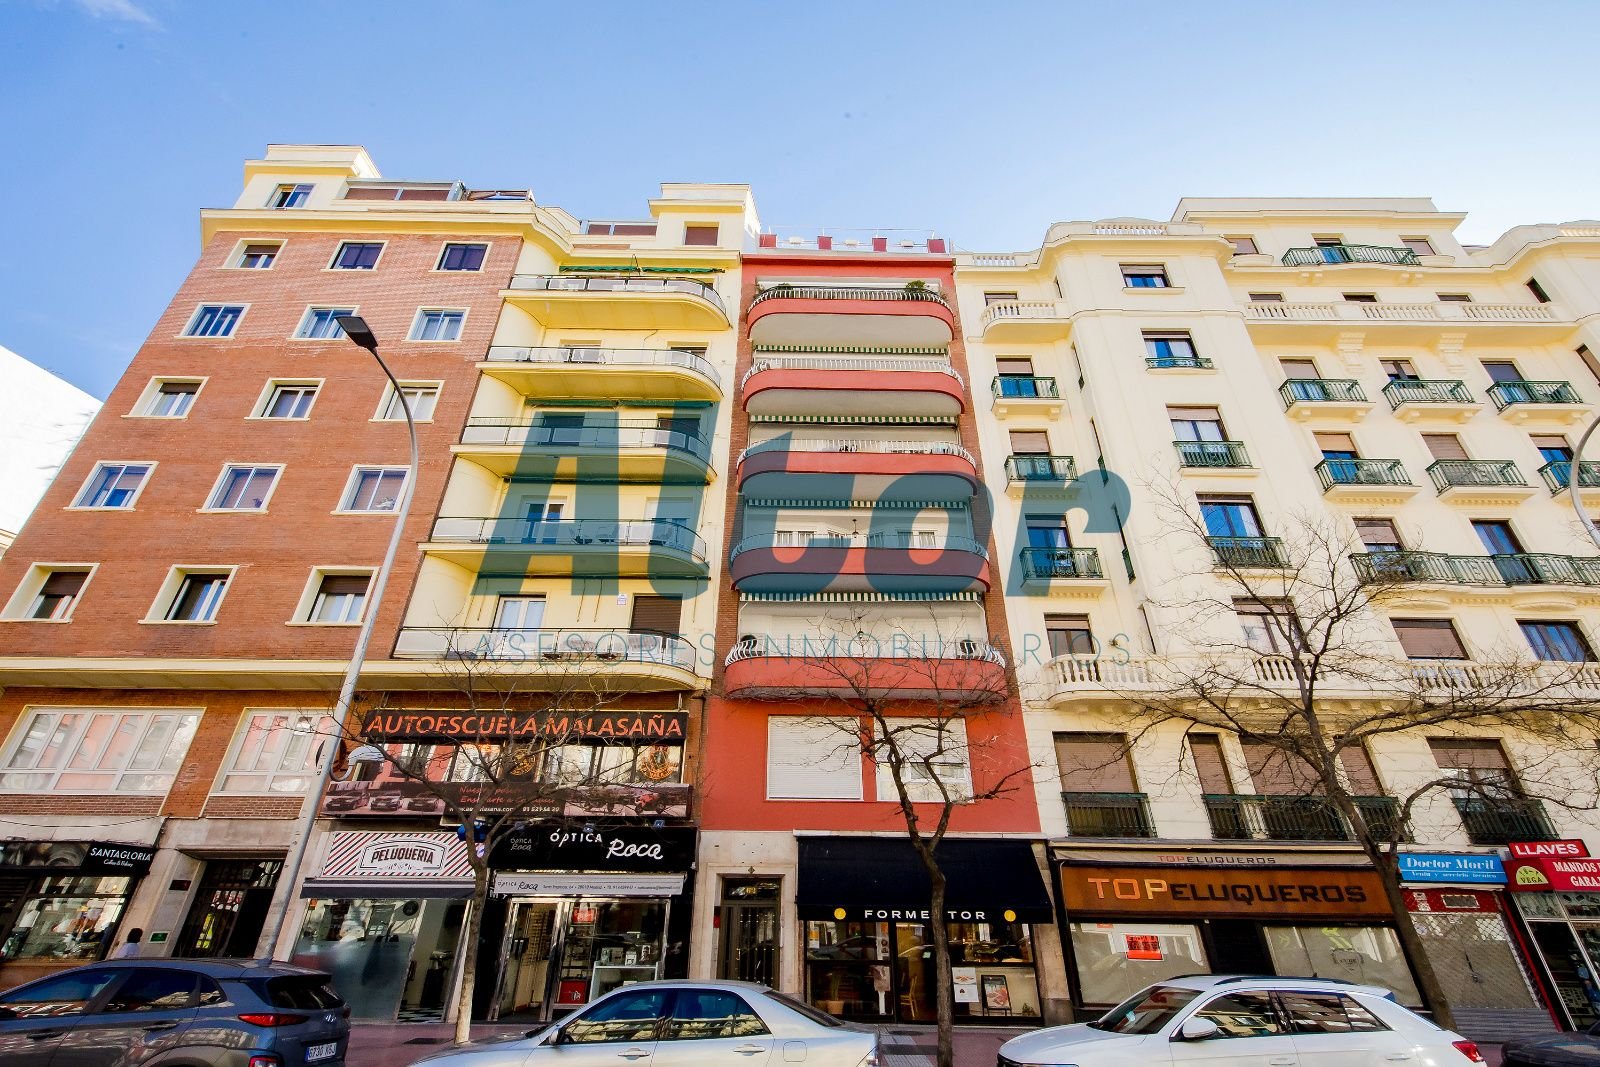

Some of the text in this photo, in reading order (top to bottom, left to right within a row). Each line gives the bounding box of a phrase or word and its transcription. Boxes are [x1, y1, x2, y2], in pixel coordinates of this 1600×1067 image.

[366, 714, 682, 737] AUTOESCUELA MALASAÑA
[90, 847, 152, 861] SANTAGLORIA
[606, 838, 664, 860] Roca
[1515, 843, 1580, 855] LLAVES
[371, 847, 434, 865] PELUQUERIA
[1158, 855, 1276, 864] TOPELUQUEROS
[1406, 857, 1452, 868] Doctor
[1552, 861, 1598, 873] MANDOS
[518, 881, 539, 891] Roca
[1087, 877, 1367, 905] TOPELUQUEROS
[864, 909, 986, 920] FORMETOR
